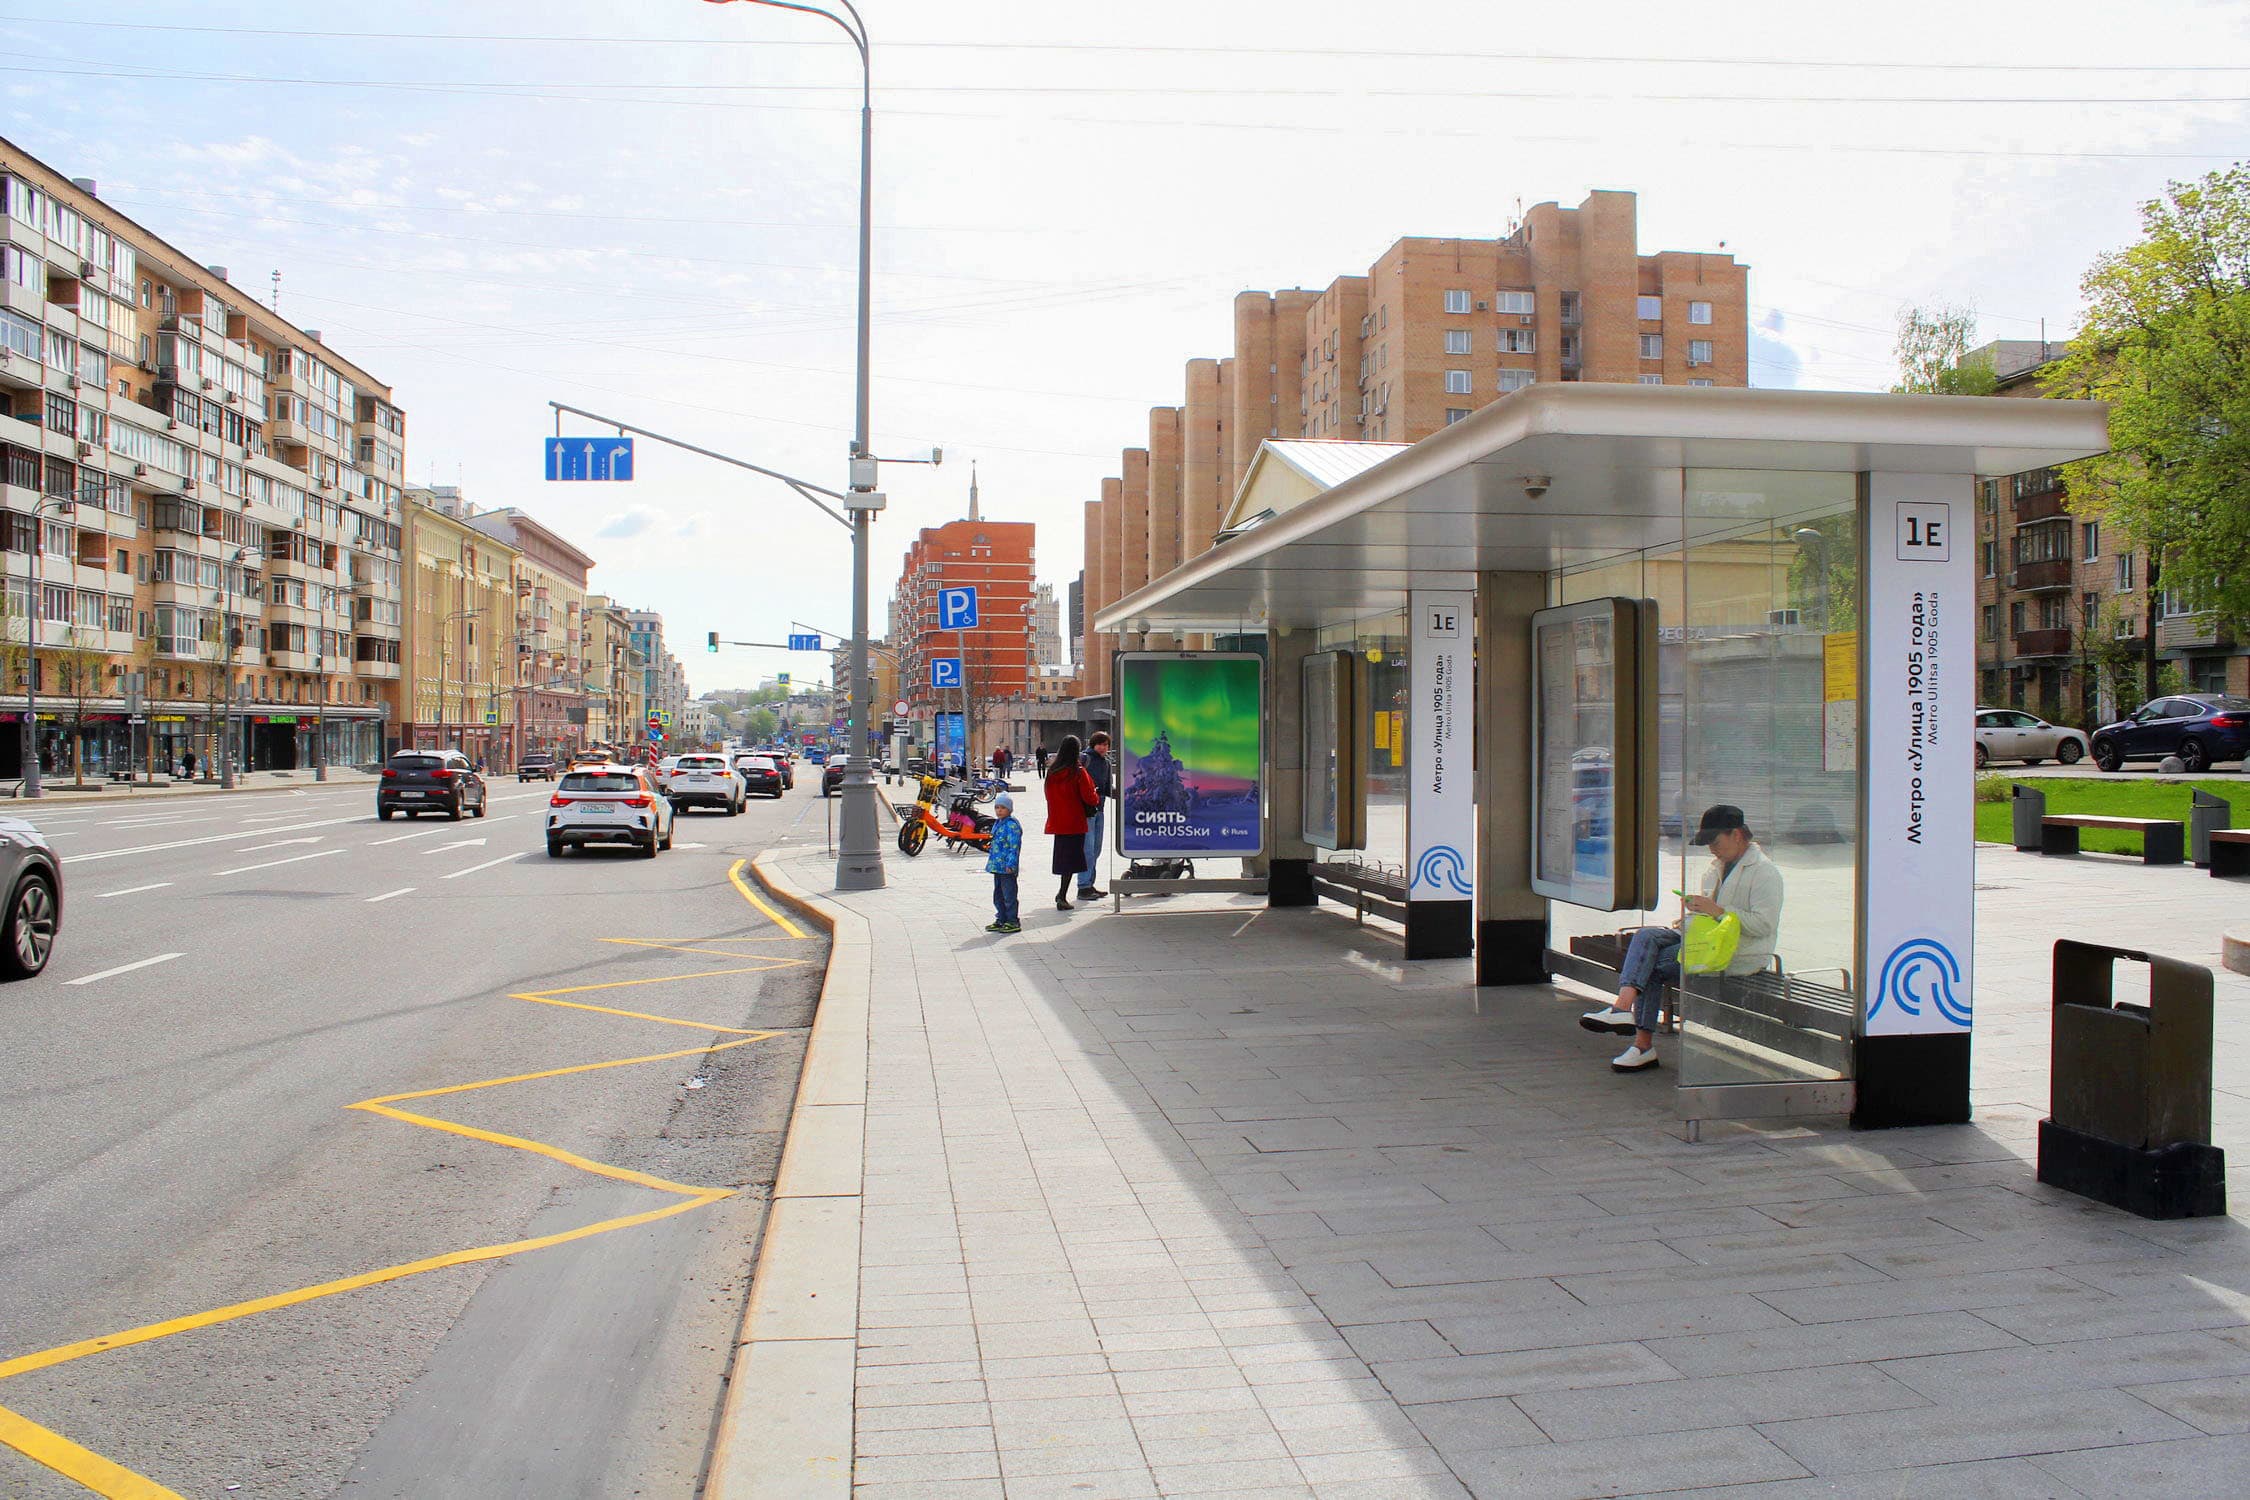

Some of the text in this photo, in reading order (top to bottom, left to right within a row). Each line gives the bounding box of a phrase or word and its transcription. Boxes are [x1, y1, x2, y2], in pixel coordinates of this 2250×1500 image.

[936, 661, 953, 685] P
[946, 590, 970, 626] P
[1927, 592, 1938, 745] Metro Ulitsa 1905 Goda
[1433, 654, 1444, 794] Метро «Улица 1905 года»
[1907, 592, 1925, 844] Метро «Улица 1905 года»
